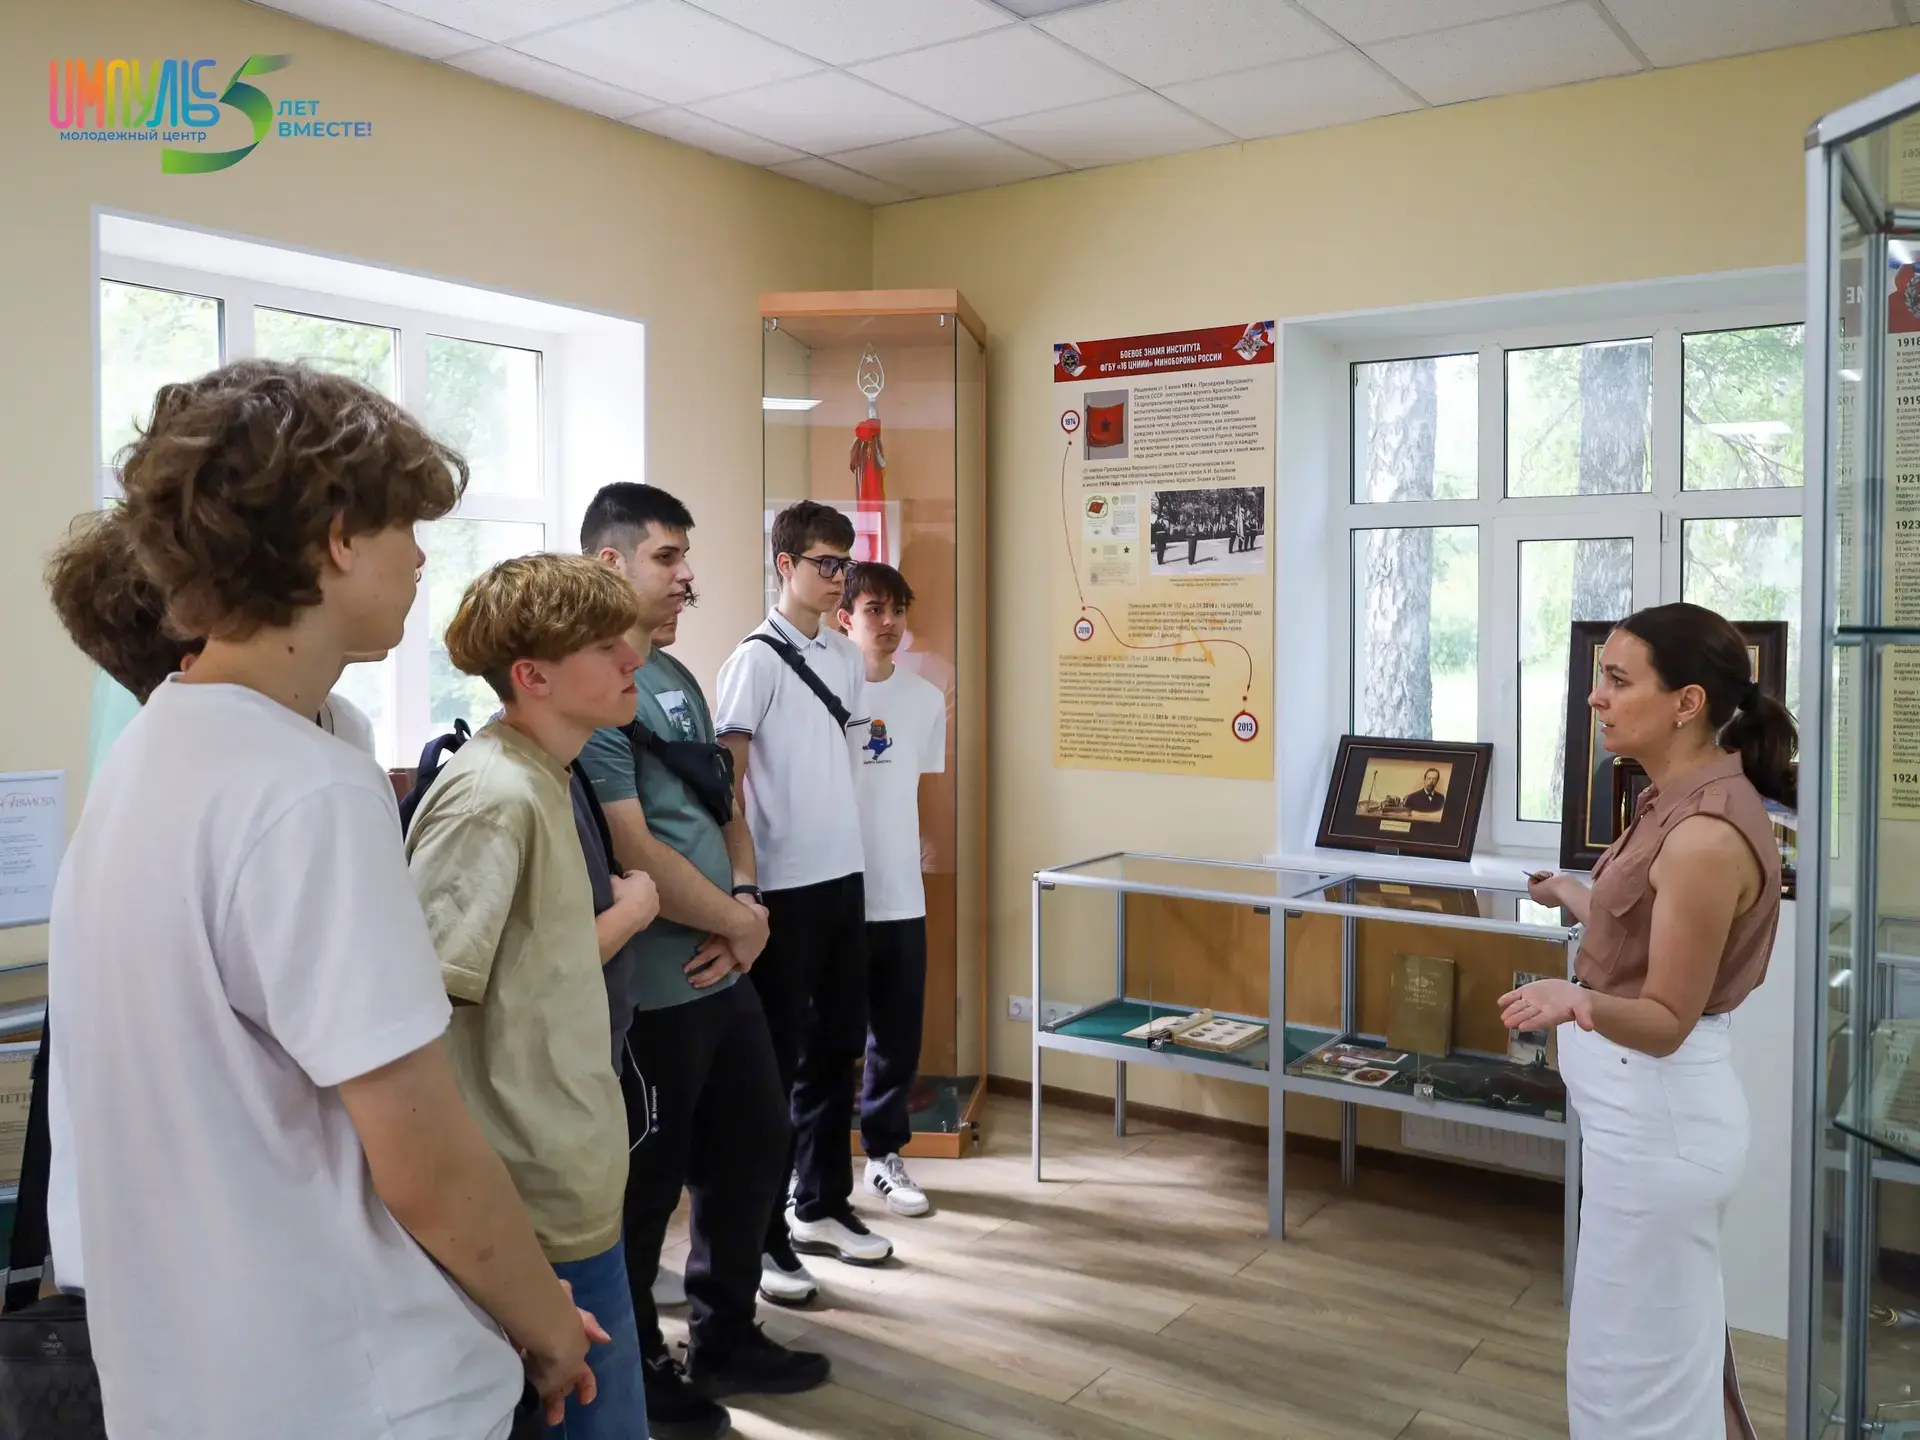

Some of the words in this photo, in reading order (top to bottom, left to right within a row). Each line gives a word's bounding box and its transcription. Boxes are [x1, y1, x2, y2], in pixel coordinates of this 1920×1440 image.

[1896, 337, 1920, 347] 1918
[1120, 349, 1143, 359] БОЕВОЕ
[1143, 346, 1166, 357] ЗНАМЯ
[1166, 343, 1201, 354] ИНСТИТУТА
[1100, 363, 1117, 372] ФГБУ
[1154, 355, 1197, 367] МИНОБОРОНЫ
[1197, 352, 1223, 363] РОССИИ
[1896, 395, 1920, 406] 1919
[1895, 474, 1920, 483] 1921
[1895, 520, 1920, 530] 1923
[1237, 722, 1253, 732] 2013
[1892, 773, 1919, 784] 1924
